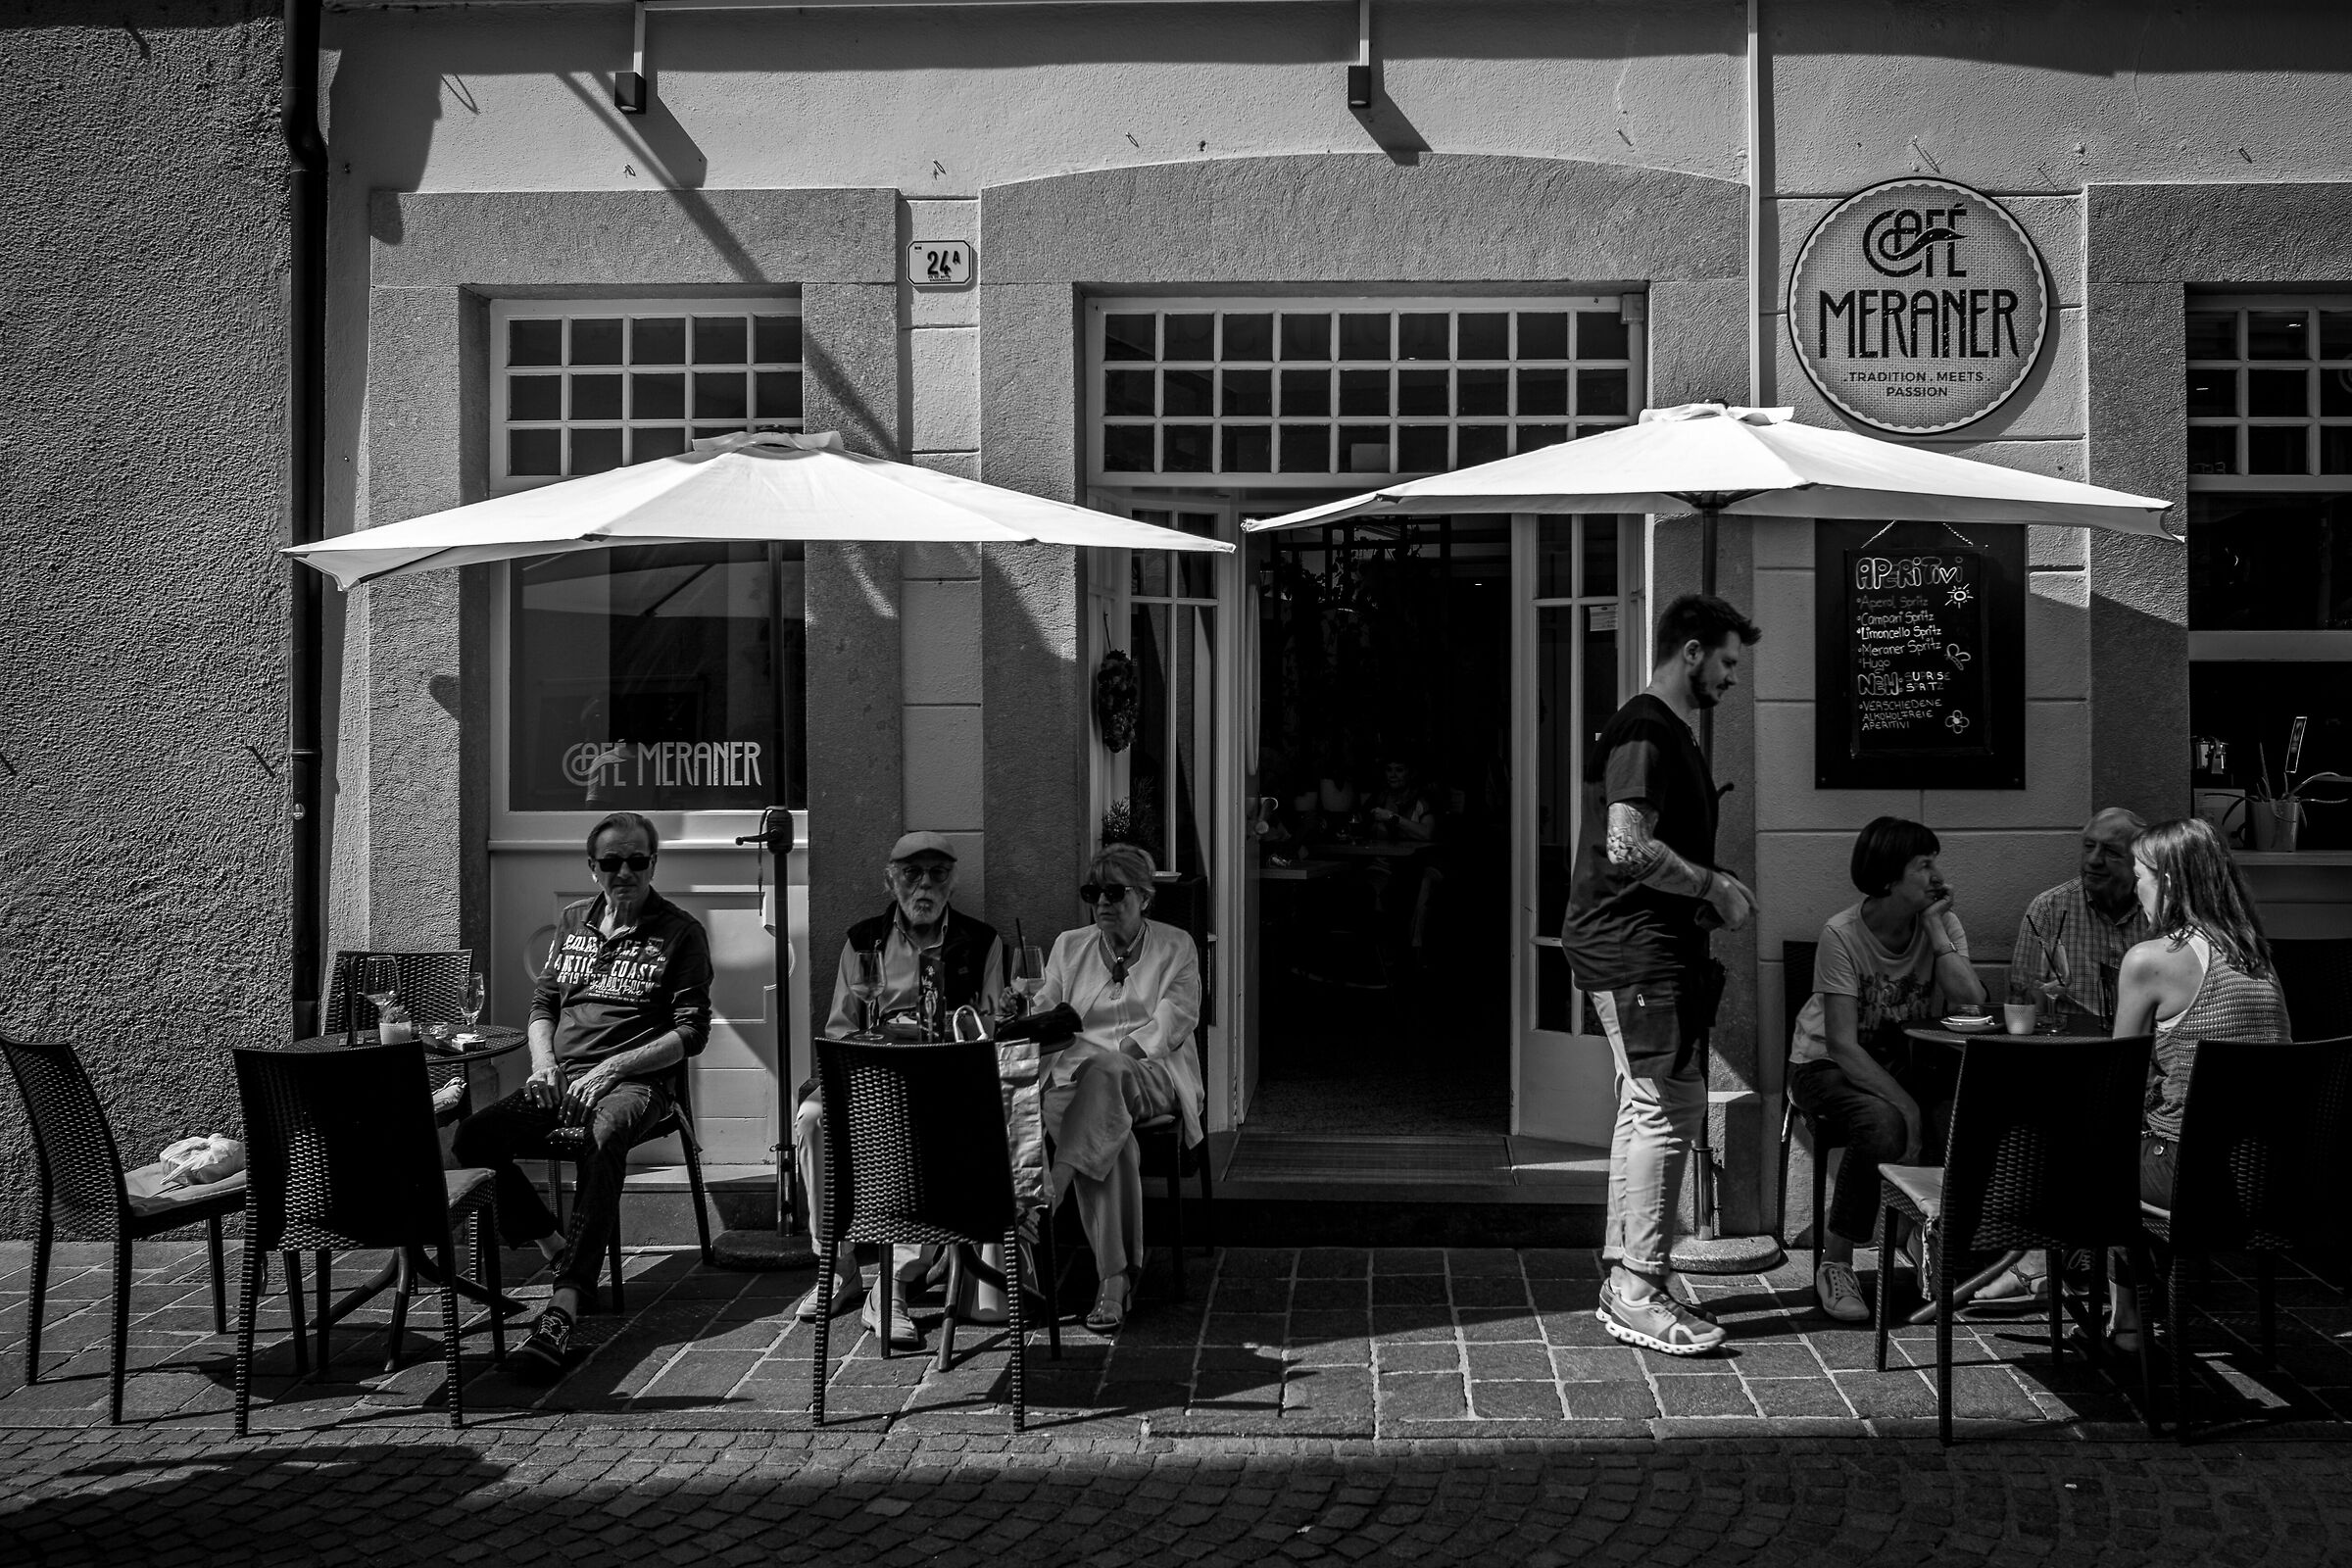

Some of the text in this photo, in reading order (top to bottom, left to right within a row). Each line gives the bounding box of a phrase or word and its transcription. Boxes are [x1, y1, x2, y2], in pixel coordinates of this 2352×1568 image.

[1820, 289, 2019, 359] MERANER
[1886, 386, 1948, 397] PASSION
[1899, 594, 1929, 610] Spritz
[1860, 610, 1935, 627] Campari Spritz
[1861, 624, 1942, 640] Limoncello Spritz
[1862, 638, 1942, 657] Meraner Spritz
[1862, 659, 1890, 673] Hugo
[1862, 698, 1942, 711] VERSCHIEDENE
[1862, 710, 1935, 722] ALKOHOLFREIE
[1861, 720, 1911, 732] APERITIVI
[637, 741, 762, 787] MERANER
[611, 959, 658, 982] COAST
